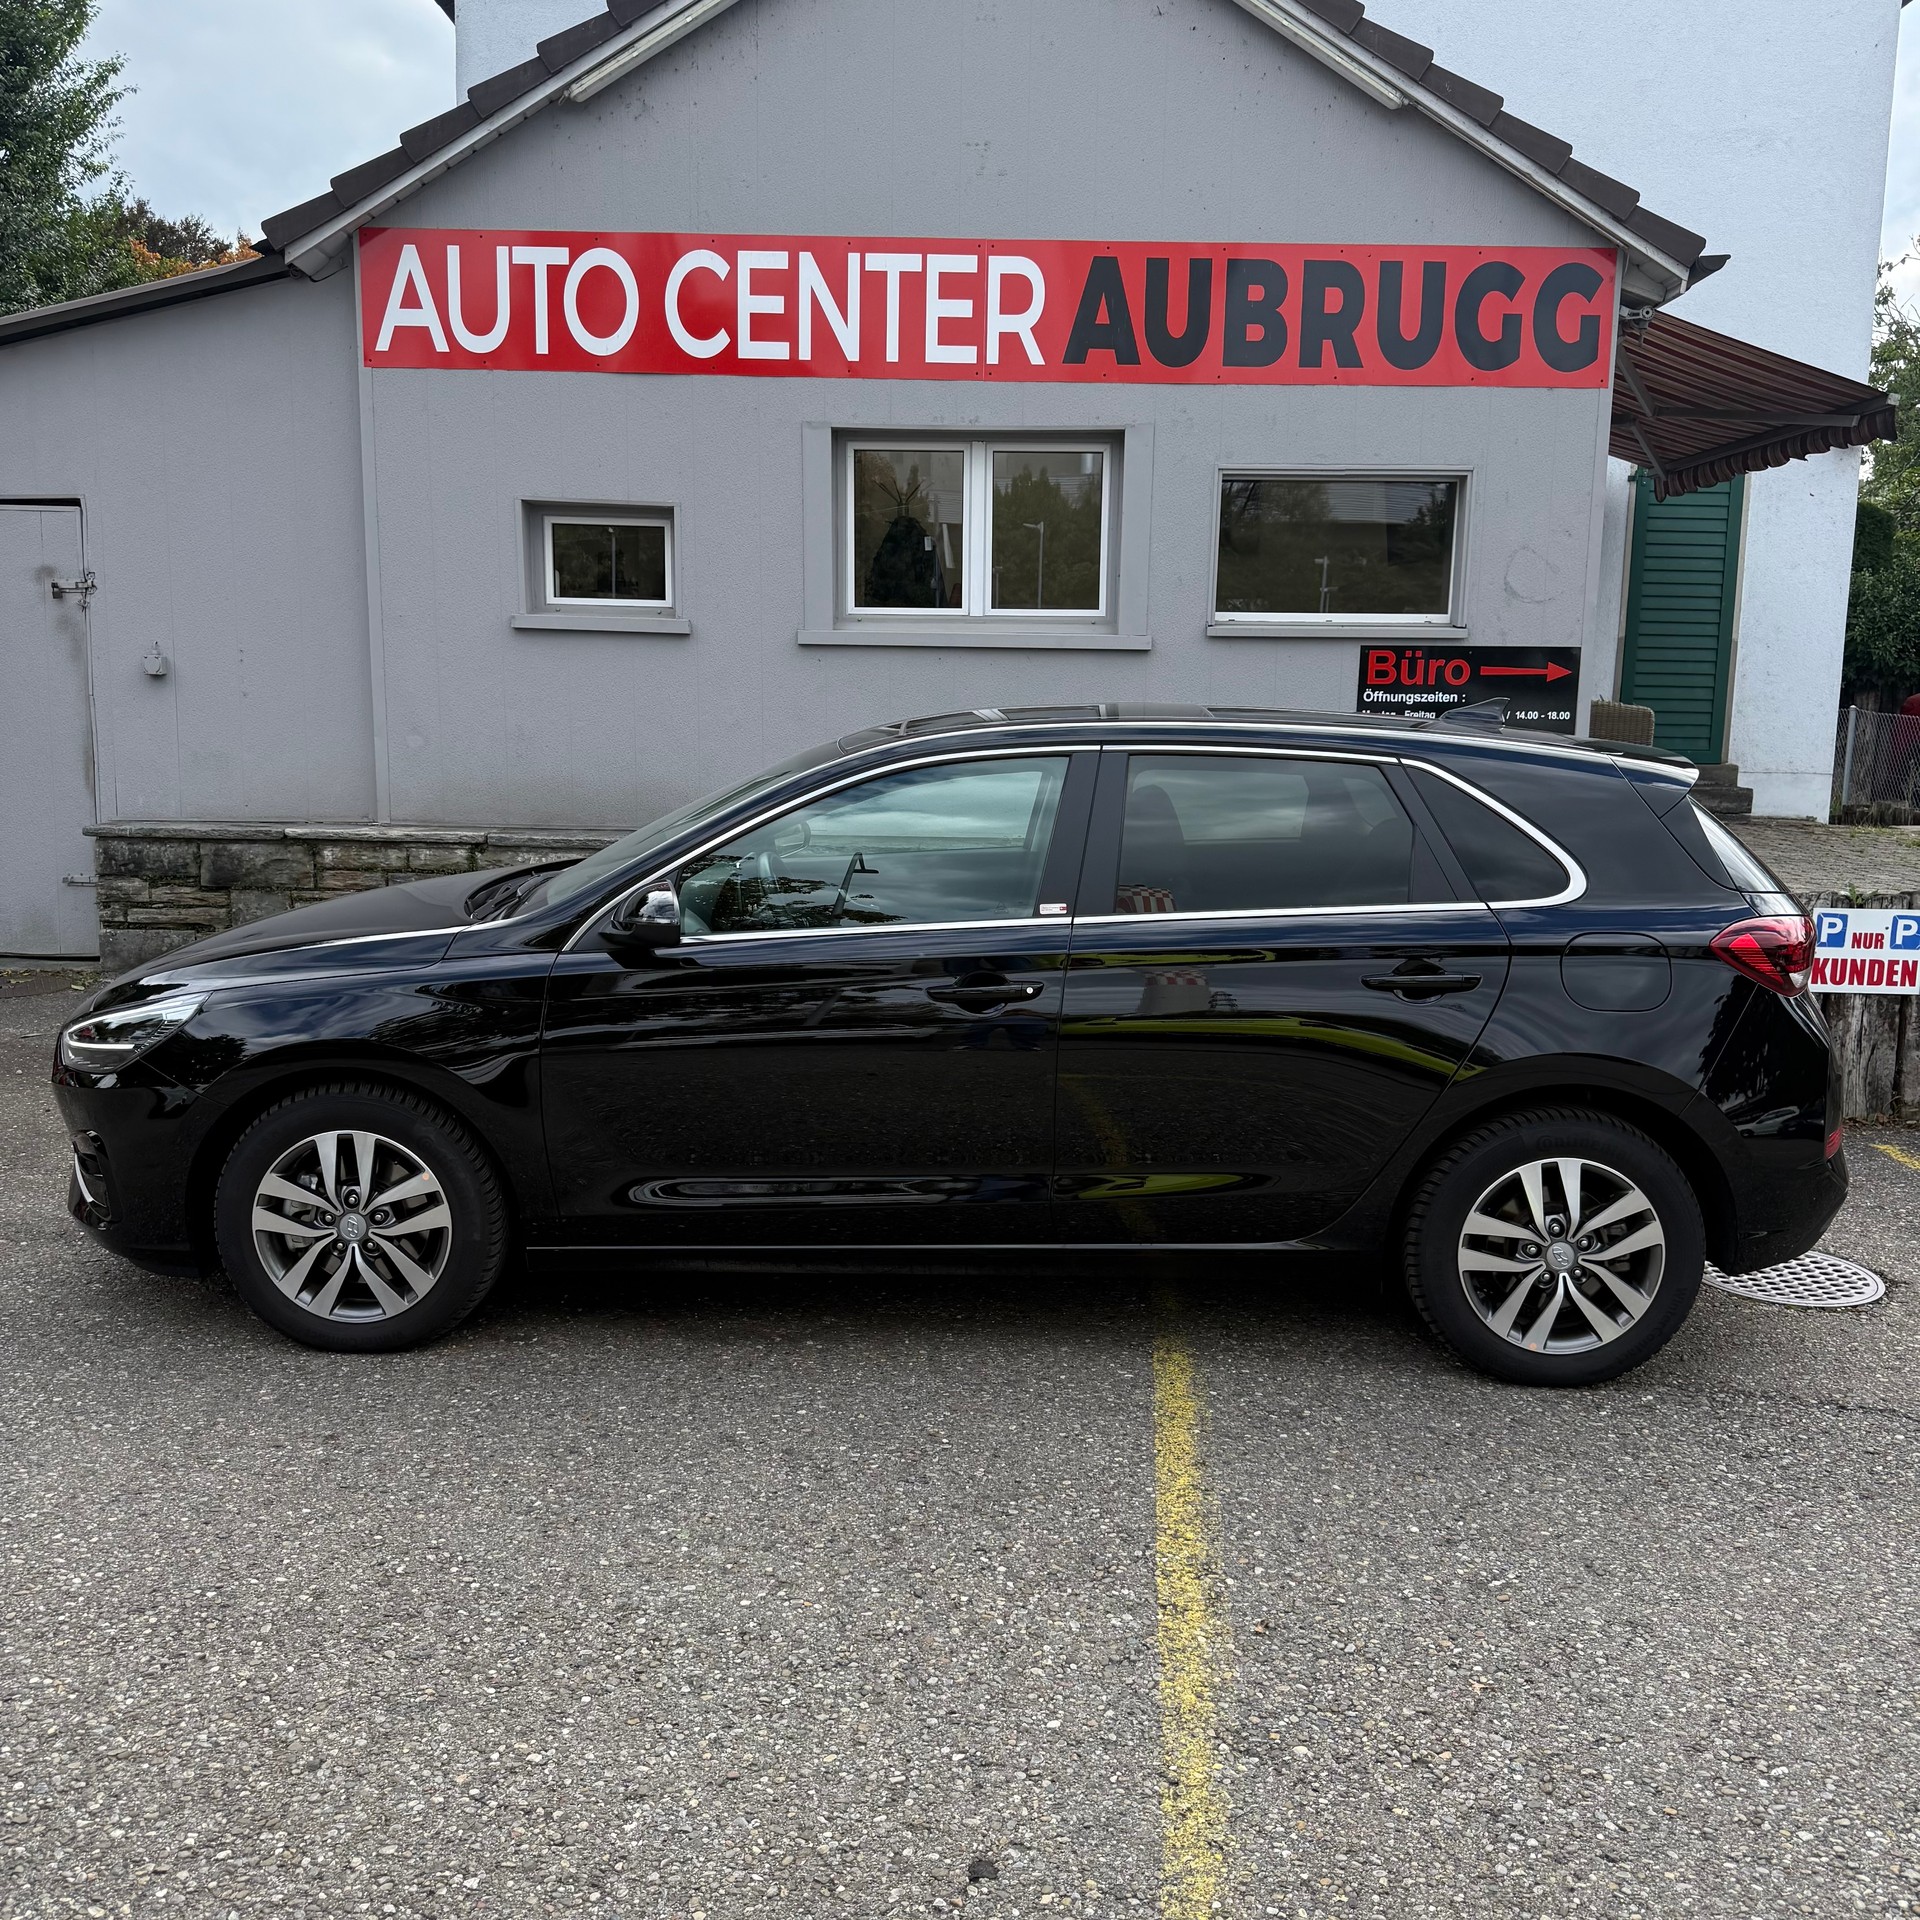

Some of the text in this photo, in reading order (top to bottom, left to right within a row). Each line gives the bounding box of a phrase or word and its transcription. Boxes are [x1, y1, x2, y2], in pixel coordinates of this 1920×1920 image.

[375, 244, 1604, 373] AUTO CENTER AUBRUGG
[1367, 650, 1471, 685] Büro
[1363, 688, 1458, 705] Öffnungszeiten
[1515, 711, 1539, 720] 14.00
[1547, 711, 1571, 720] 18.00
[1851, 932, 1884, 949] NUR
[1811, 958, 1918, 987] KUNDEN
